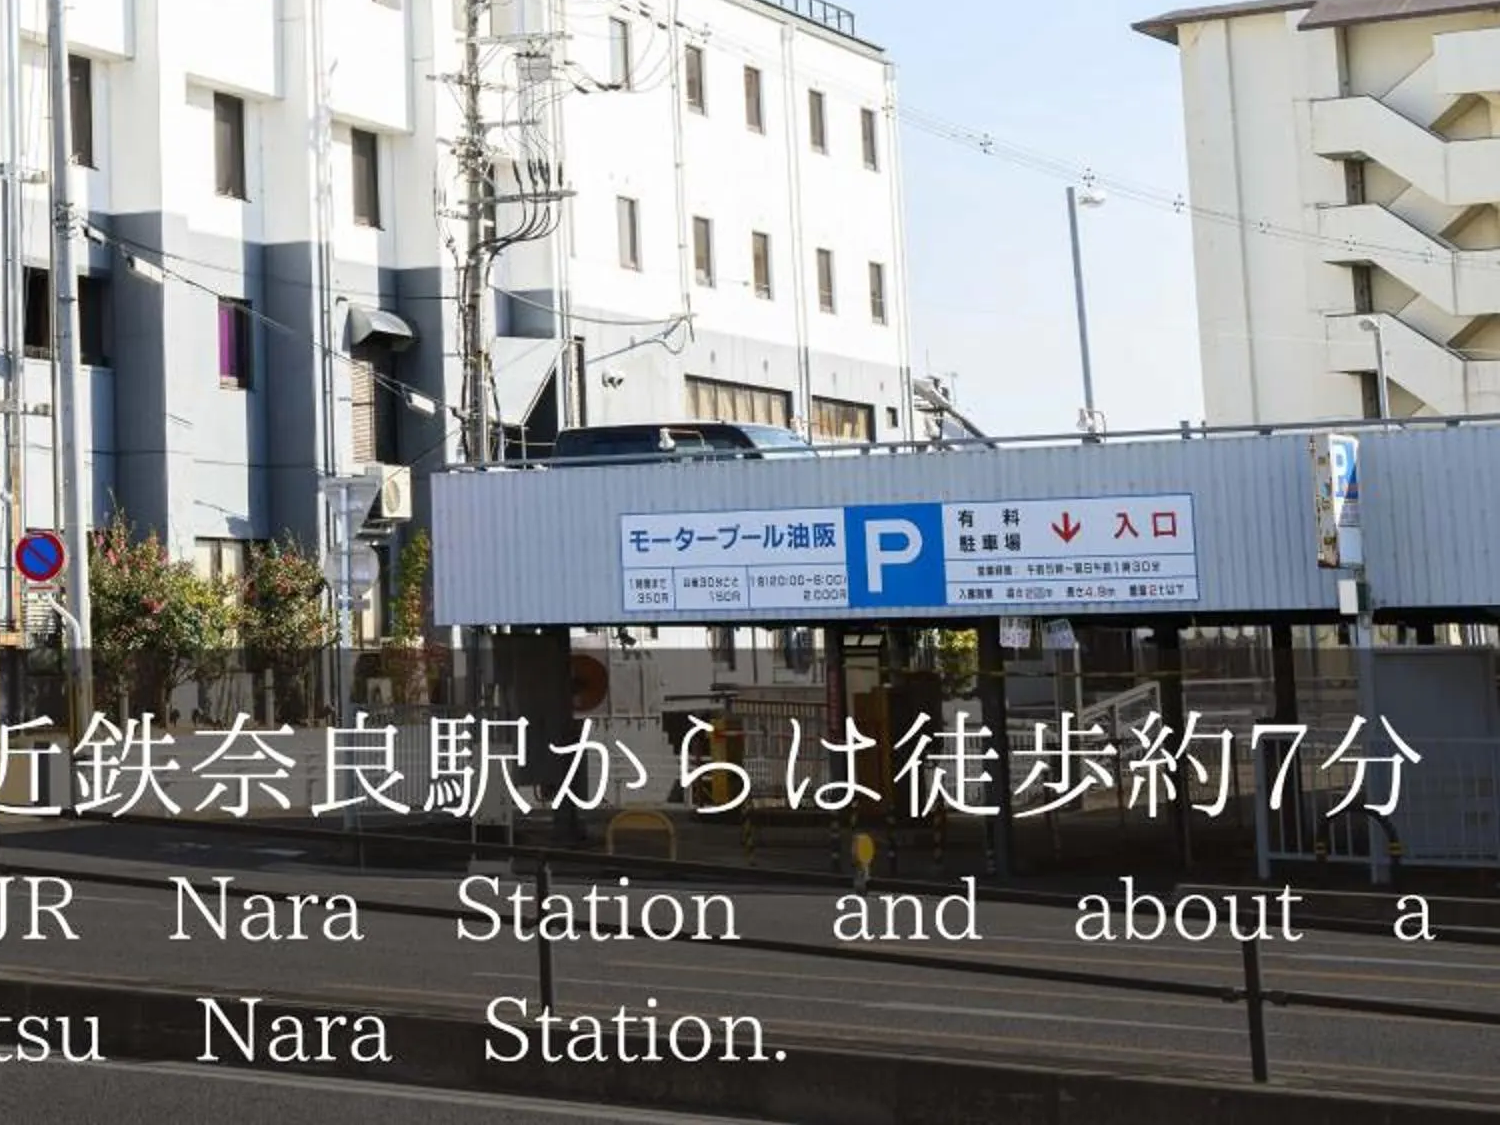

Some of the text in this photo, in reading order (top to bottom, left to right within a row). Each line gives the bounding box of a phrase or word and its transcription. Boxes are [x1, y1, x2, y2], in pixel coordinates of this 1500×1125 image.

[958, 508, 1020, 528] 有料
[1114, 510, 1178, 539] 入口
[629, 522, 836, 552] モータープール油阪
[959, 533, 1022, 552] 駐車場
[864, 519, 923, 594] P
